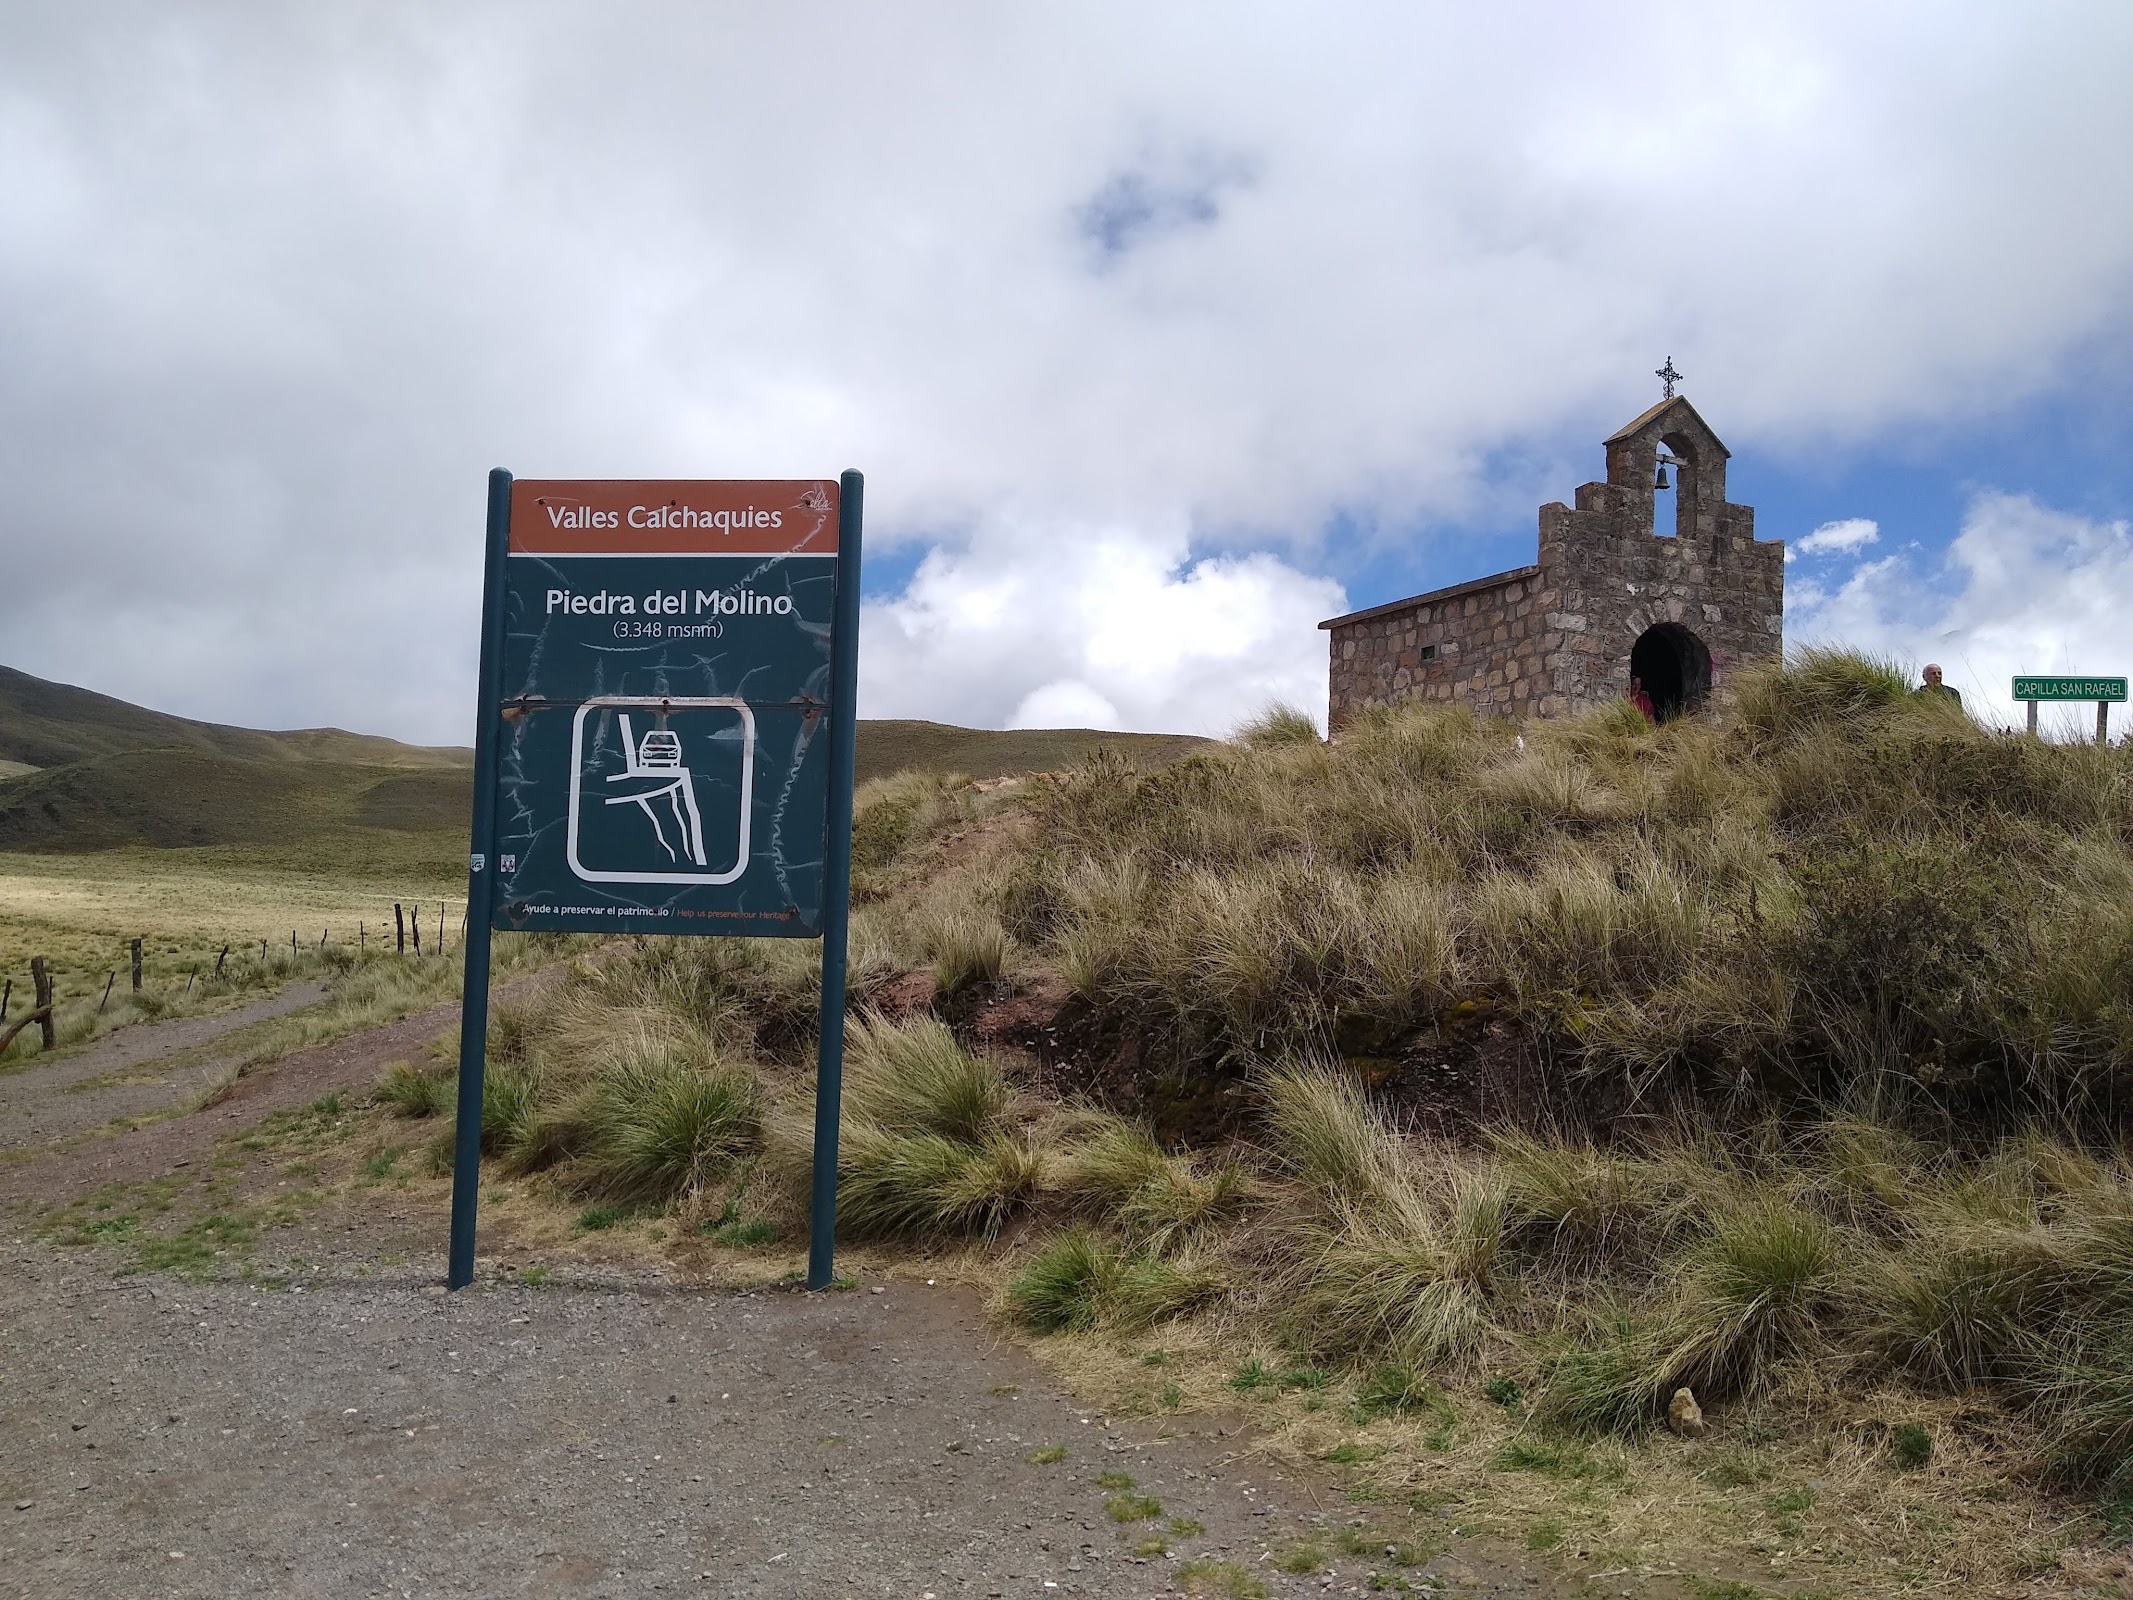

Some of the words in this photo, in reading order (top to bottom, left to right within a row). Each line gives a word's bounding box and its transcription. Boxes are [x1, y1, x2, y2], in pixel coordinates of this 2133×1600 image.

[546, 505, 619, 529] Valles
[627, 505, 783, 535] Calchaquies
[546, 589, 636, 615] Piedra
[643, 589, 687, 615] del
[695, 589, 793, 615] Molino
[612, 621, 663, 639] (3.348
[667, 621, 724, 639] msnm)
[2015, 682, 2059, 695] CAPILLA
[2060, 682, 2082, 695] SAN
[2084, 683, 2124, 696] RAFAEL
[522, 903, 551, 916] Ayude
[553, 905, 559, 914] a
[561, 905, 605, 917] preservar
[607, 905, 615, 915] el
[617, 906, 669, 918] patrimoio
[677, 908, 695, 918] Help
